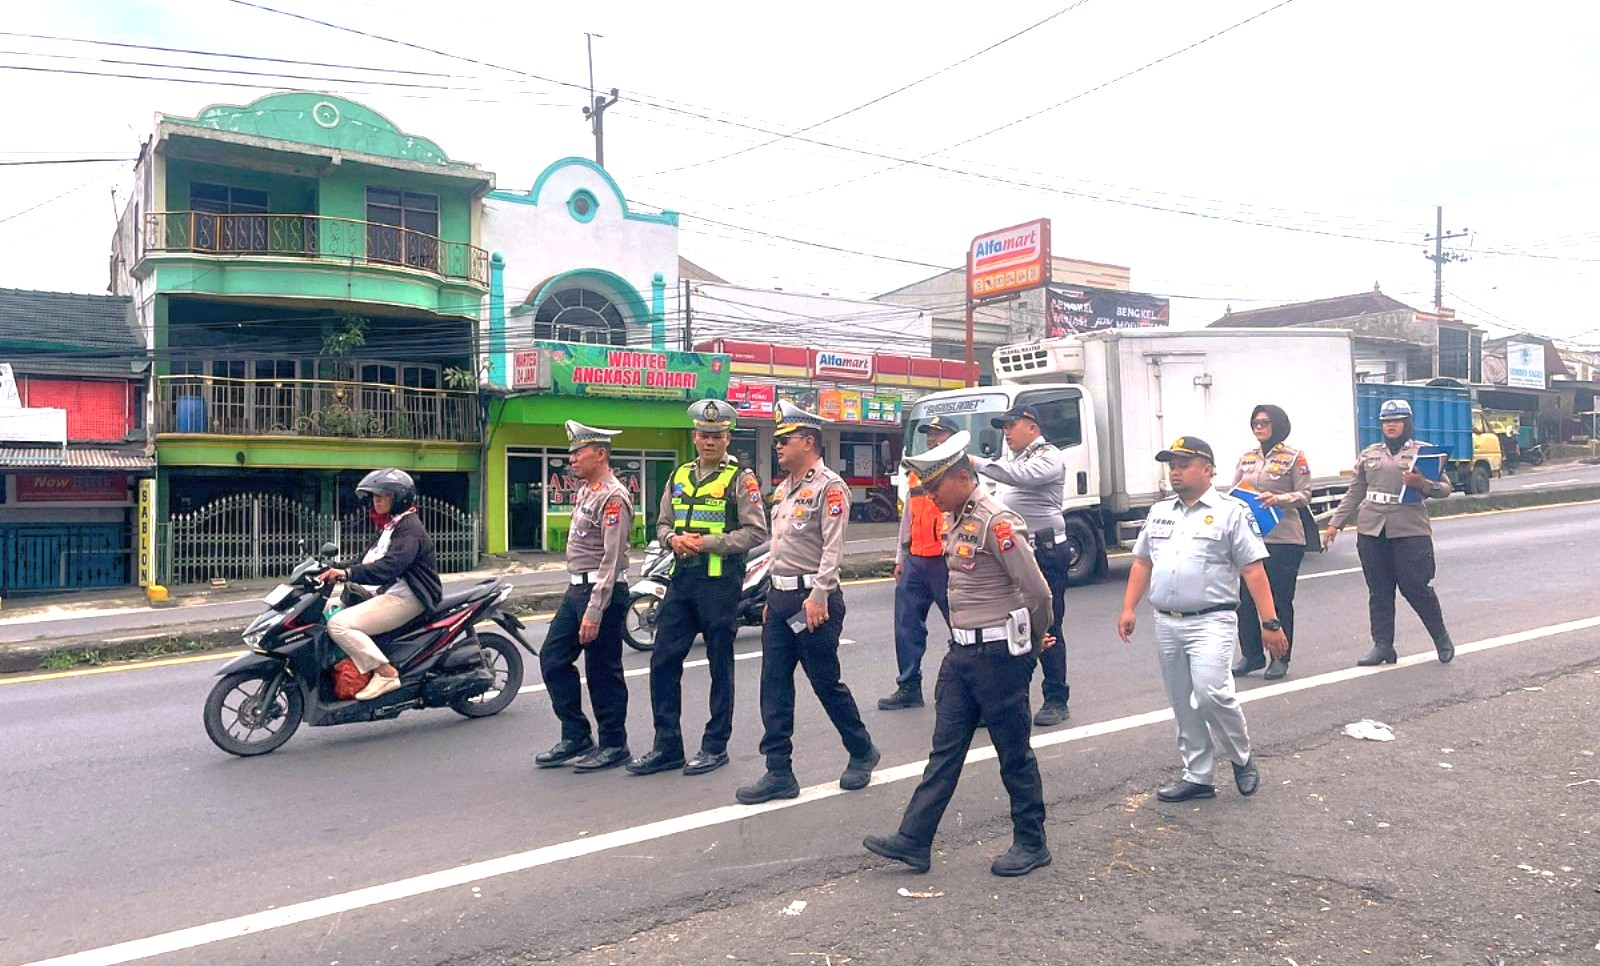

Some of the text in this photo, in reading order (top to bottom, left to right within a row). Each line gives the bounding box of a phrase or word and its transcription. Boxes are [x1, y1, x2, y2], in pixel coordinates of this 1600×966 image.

[976, 230, 1037, 258] Alfamart
[1116, 306, 1157, 320] BENGKEL
[607, 350, 667, 370] WARTEG
[819, 354, 869, 369] Alfamart
[572, 366, 697, 388] ANGKASA BAHARI
[33, 476, 70, 488] New
[141, 490, 149, 582] SABLON
